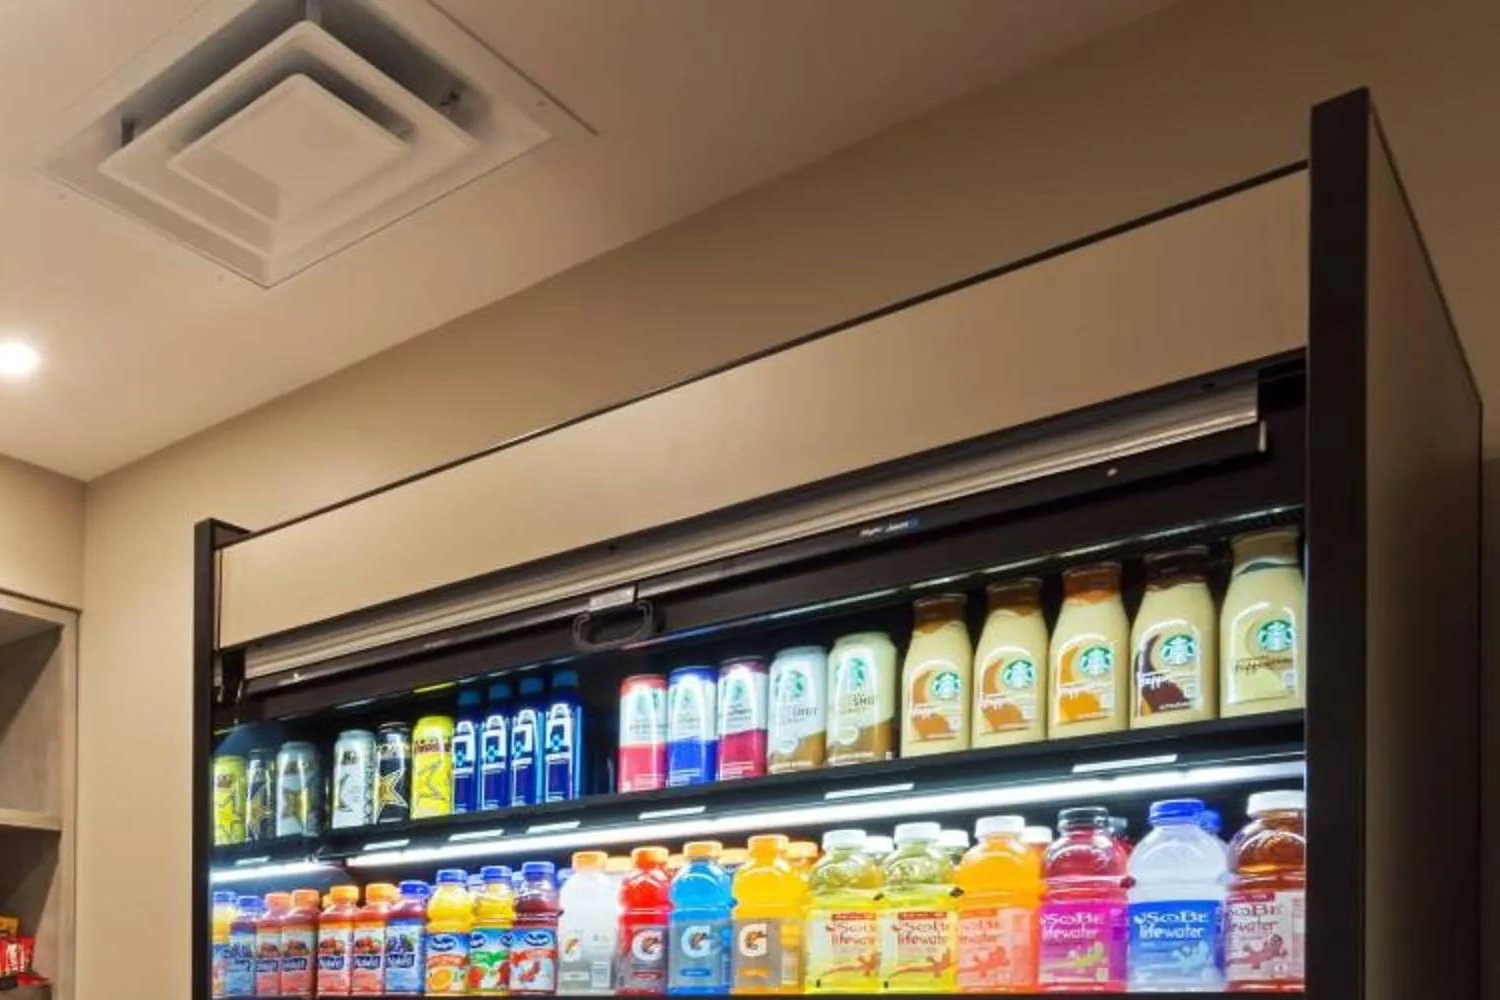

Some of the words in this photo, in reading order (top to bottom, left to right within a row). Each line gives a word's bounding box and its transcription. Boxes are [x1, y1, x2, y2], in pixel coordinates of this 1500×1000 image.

[632, 930, 663, 961] G
[681, 925, 711, 958] G
[739, 923, 768, 957] G
[1140, 923, 1204, 938] lifewater
